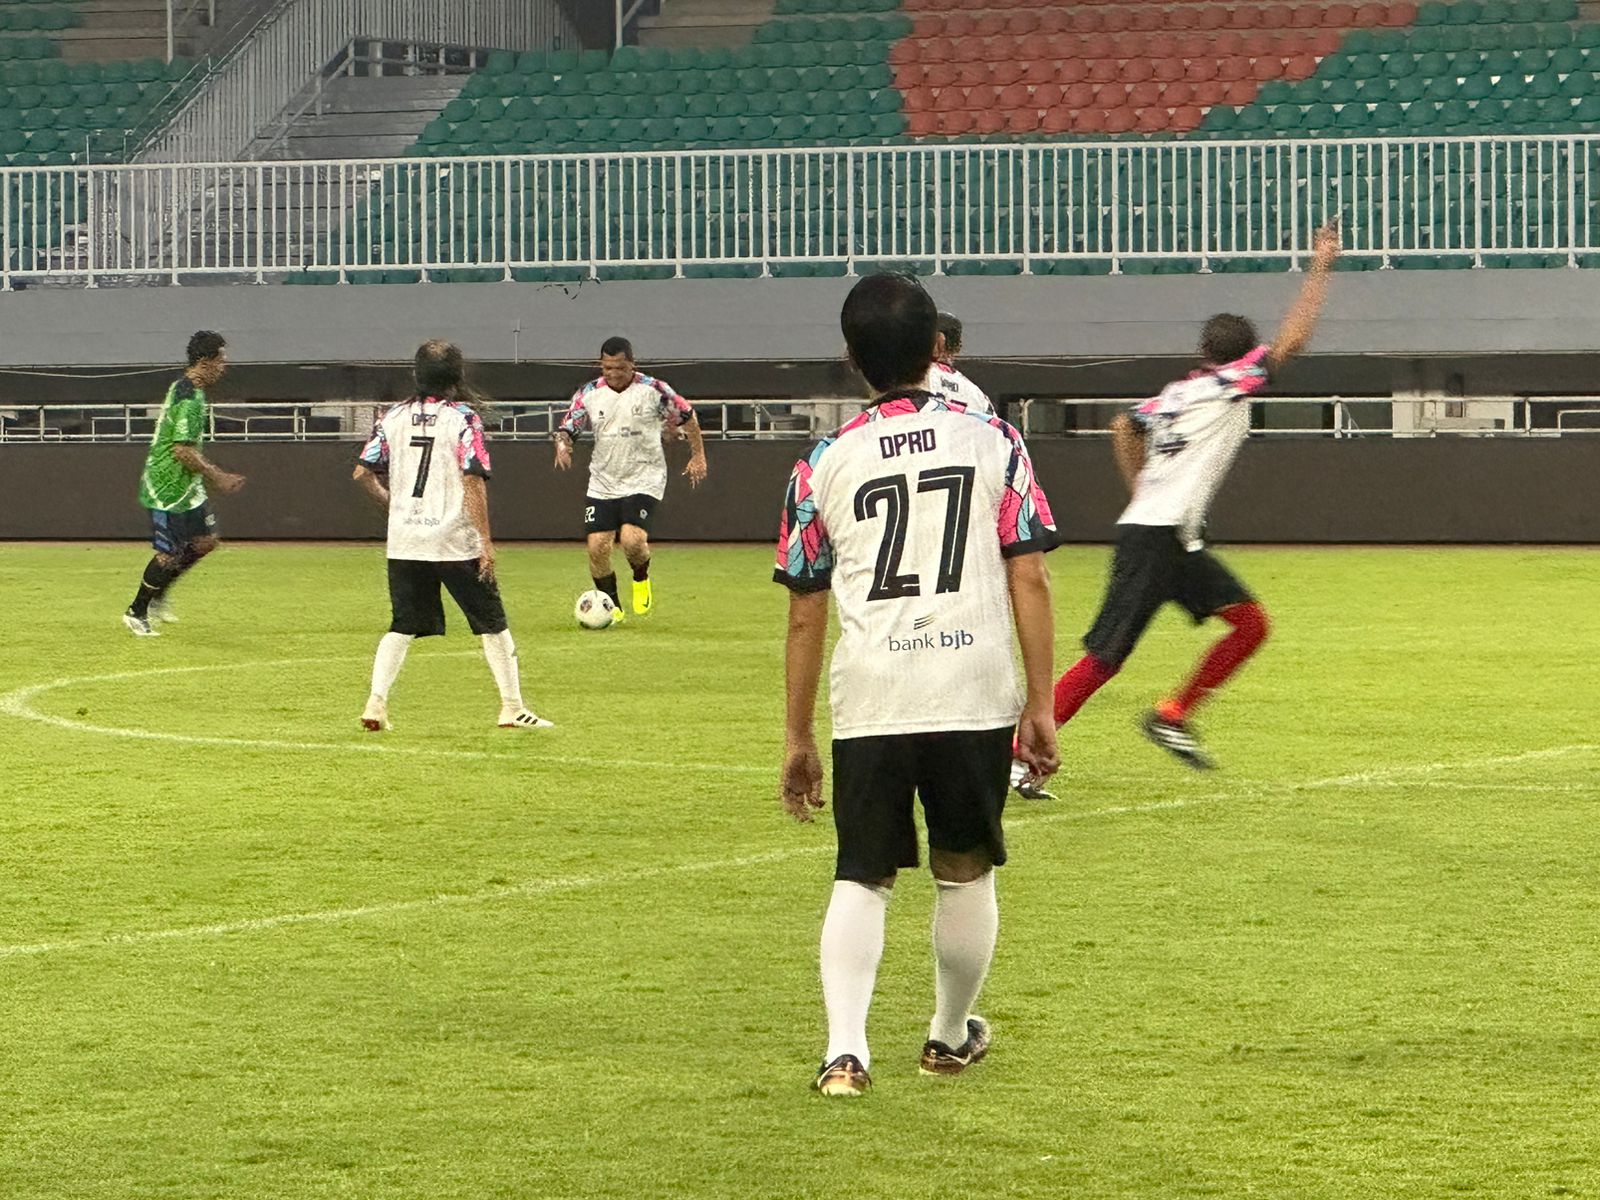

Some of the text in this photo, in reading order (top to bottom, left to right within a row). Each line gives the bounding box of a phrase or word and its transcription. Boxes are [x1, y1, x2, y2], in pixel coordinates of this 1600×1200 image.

[409, 435, 435, 498] 7
[879, 428, 937, 459] DPRD
[853, 466, 976, 602] 27
[888, 629, 975, 653] bank bjb
